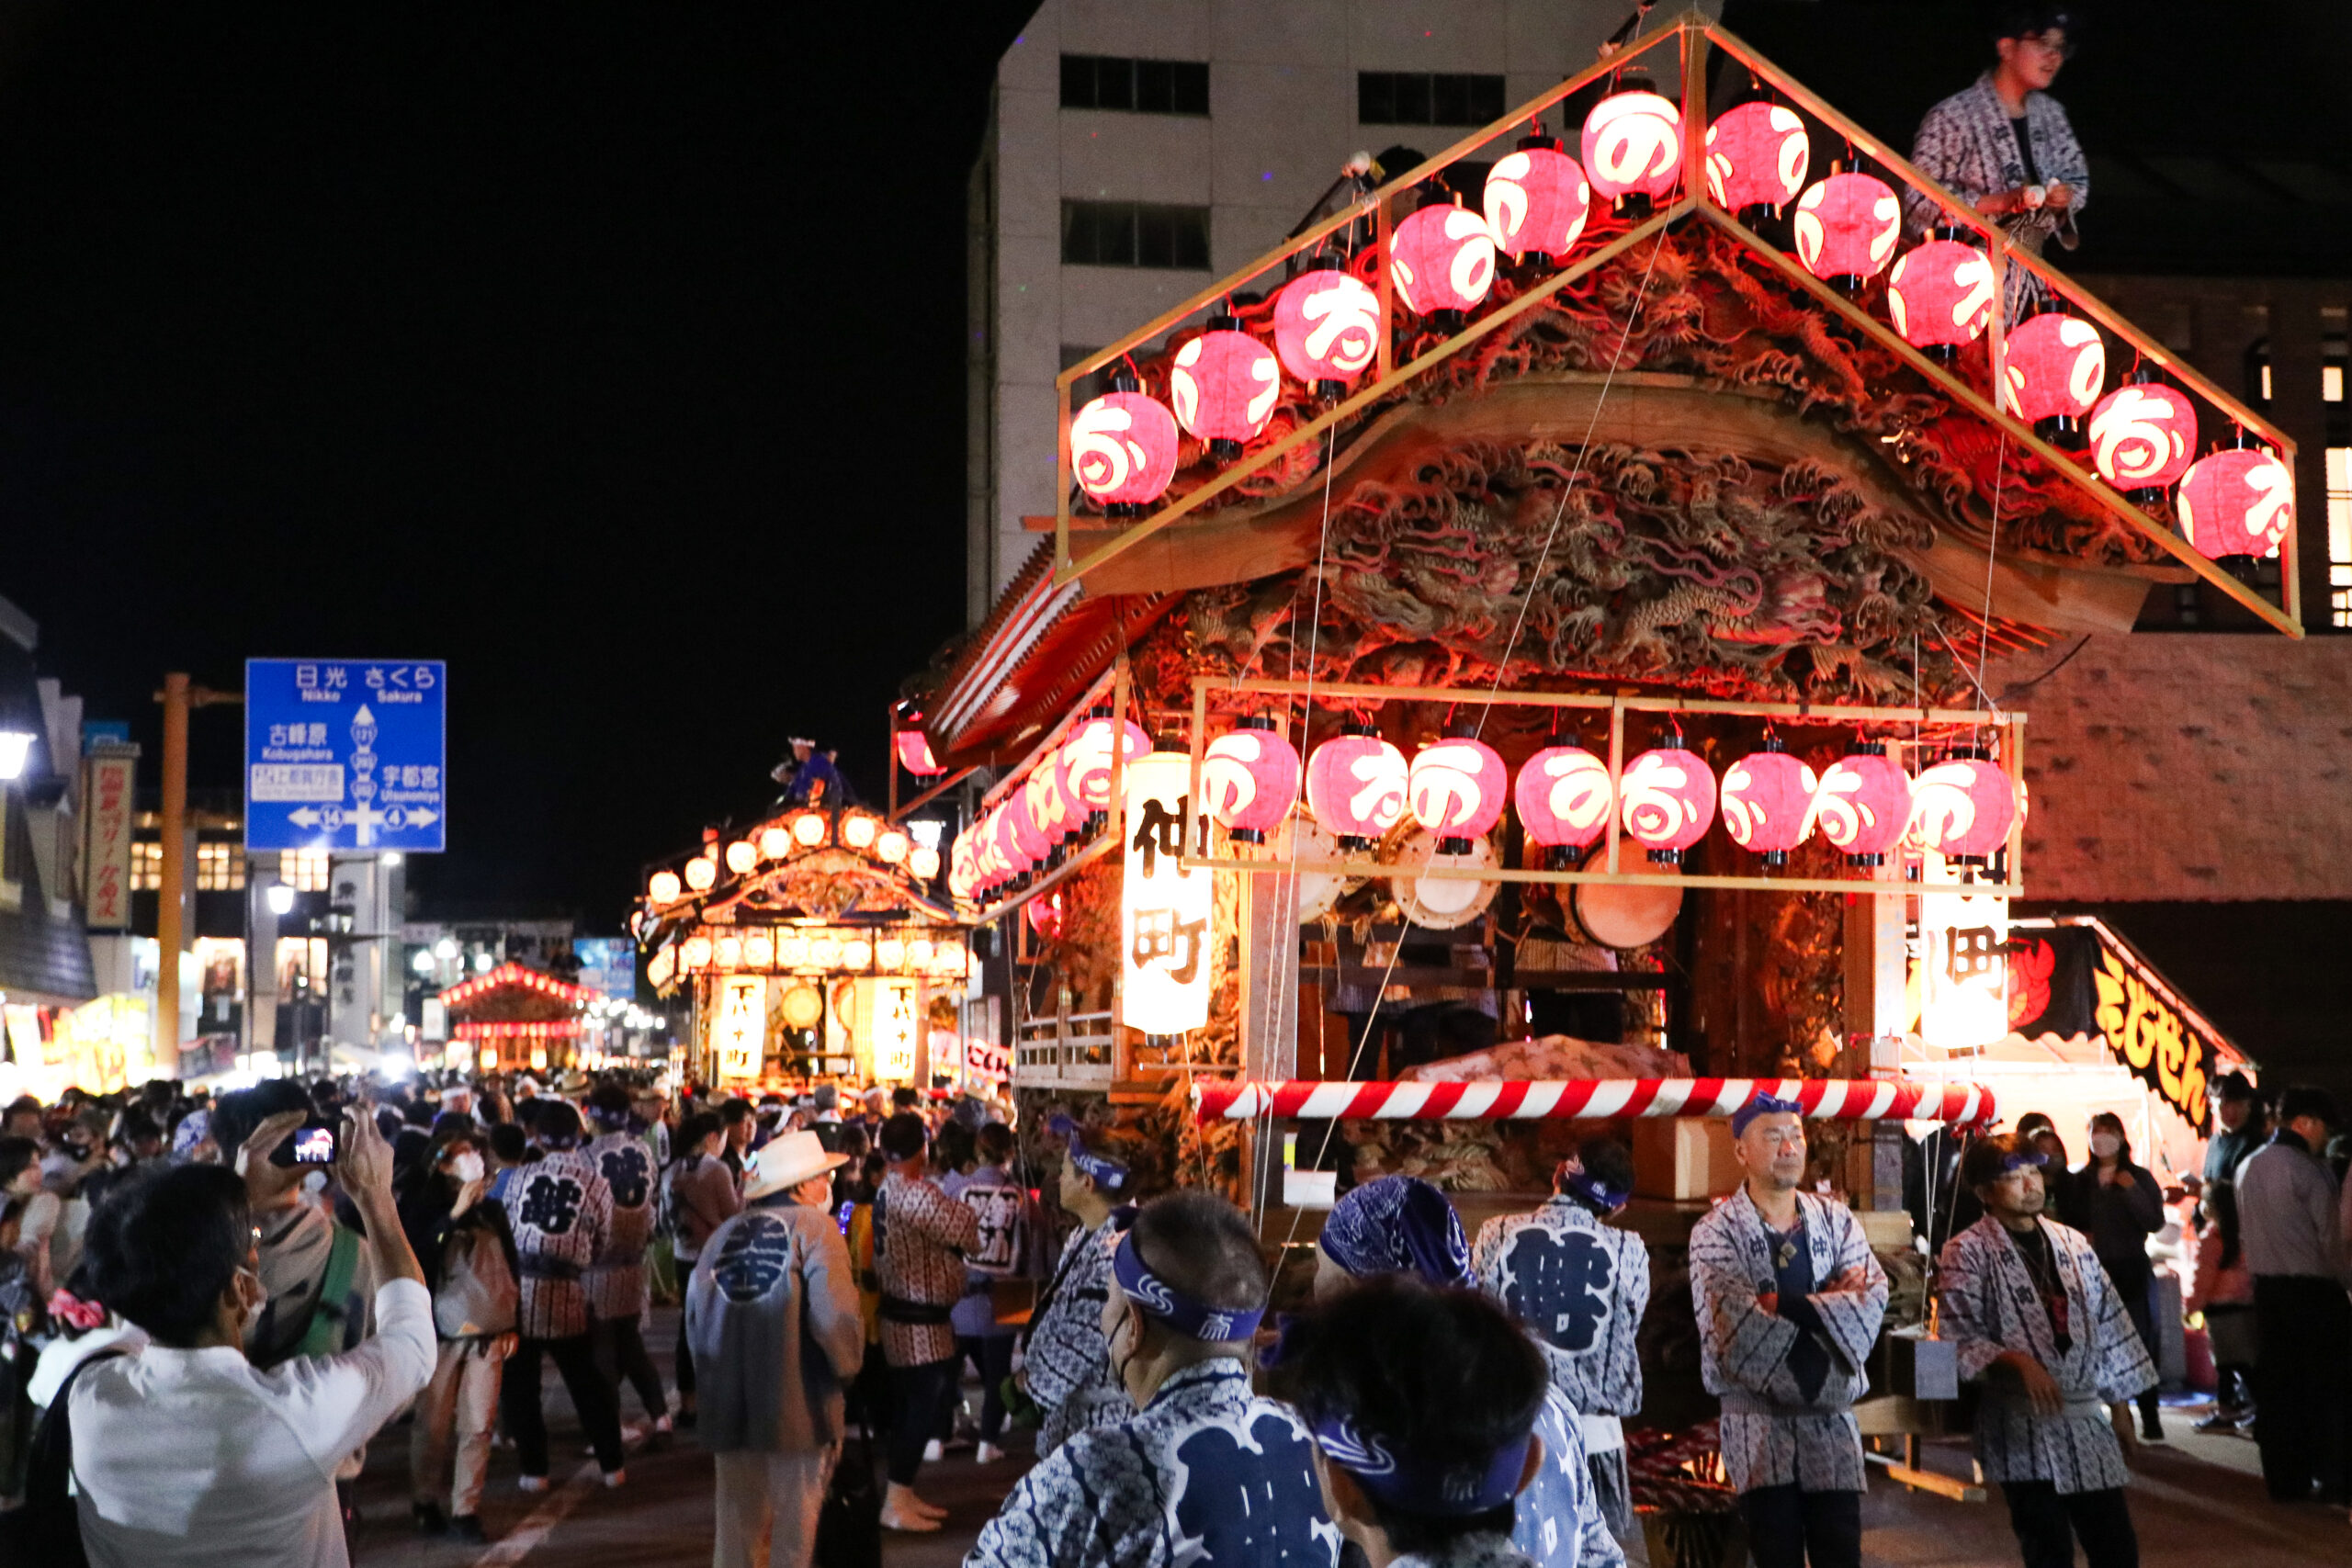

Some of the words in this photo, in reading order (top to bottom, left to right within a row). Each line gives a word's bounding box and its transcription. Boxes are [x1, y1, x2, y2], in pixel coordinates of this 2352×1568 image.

[296, 664, 348, 688] 日光
[365, 666, 435, 689] さくら
[301, 690, 341, 703] Nikko
[377, 691, 423, 704] Sakura
[382, 765, 439, 788] 宇都宮
[322, 809, 341, 825] 14
[388, 809, 401, 825] 4
[1132, 797, 1210, 985] 仲町
[2093, 945, 2206, 1126] えびせん
